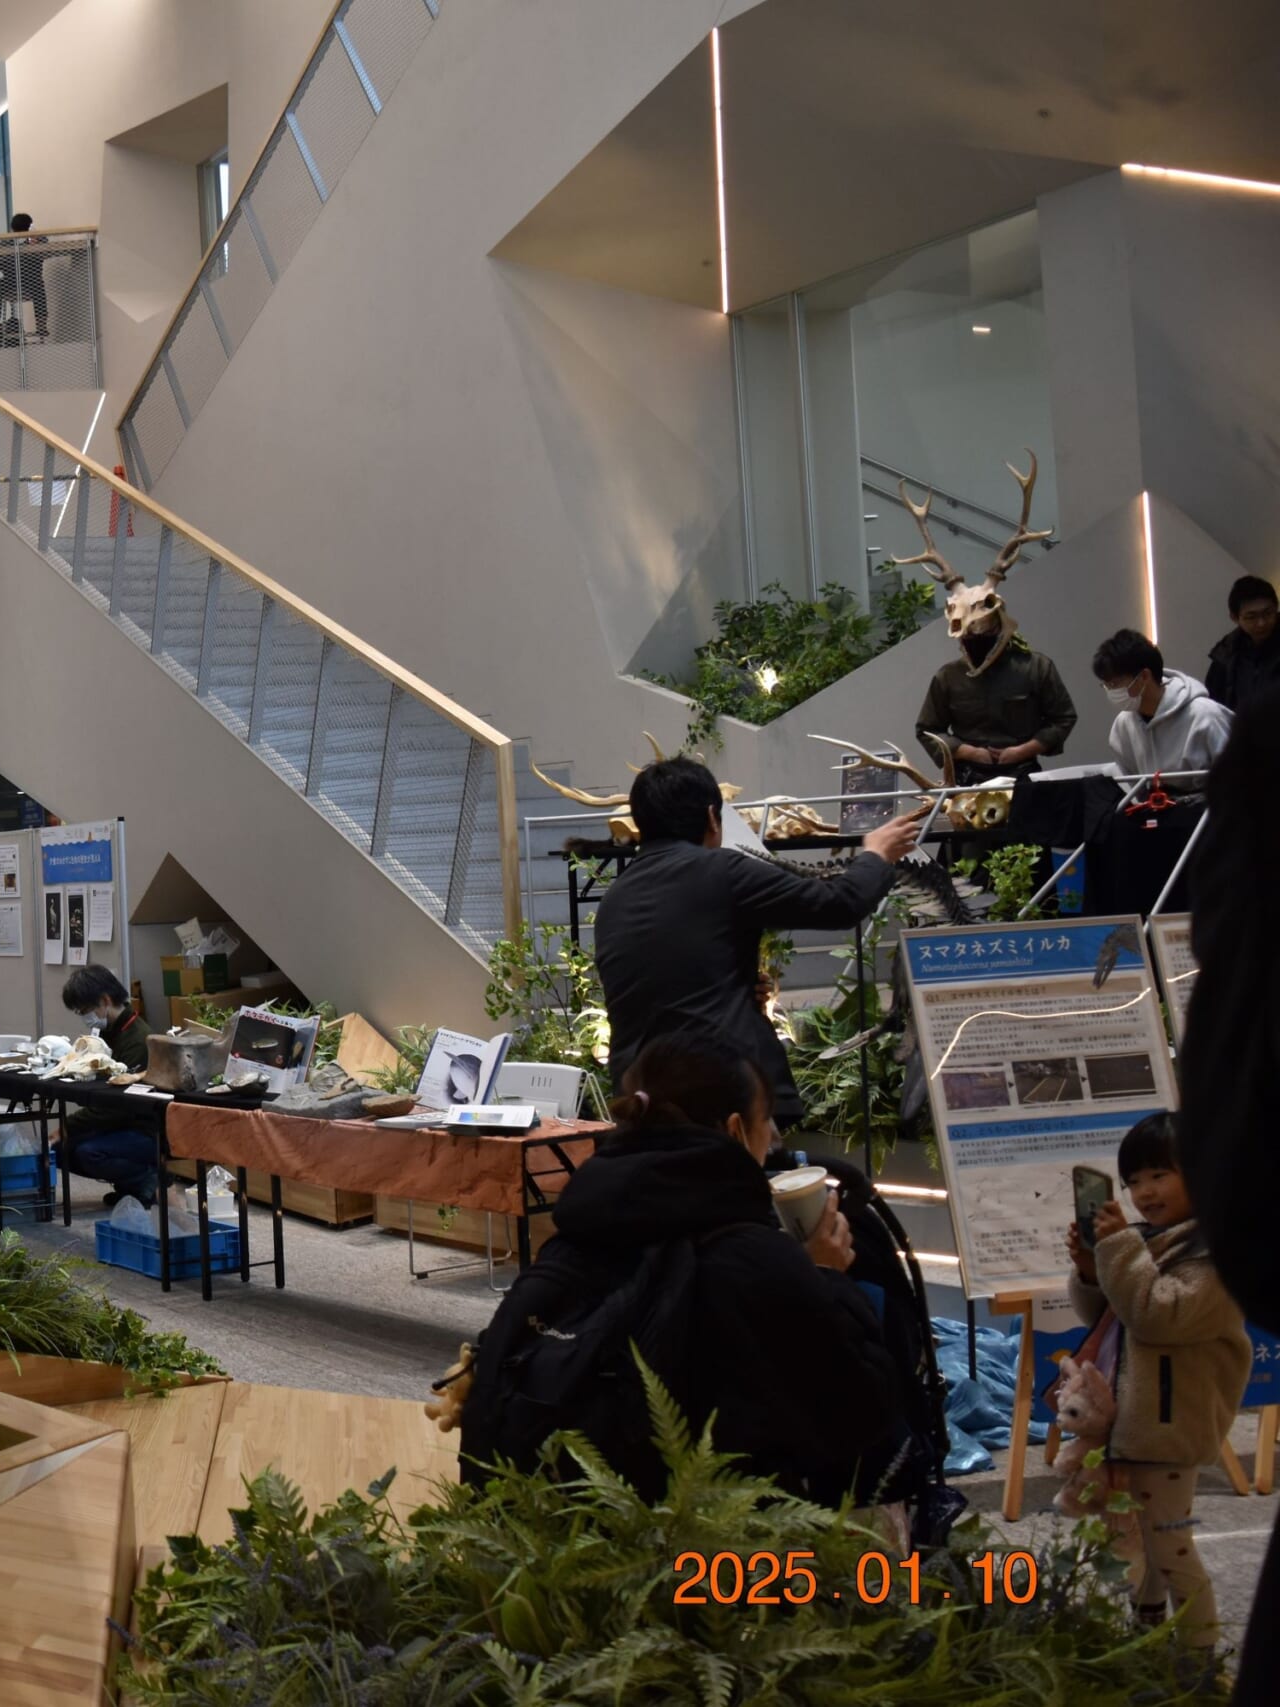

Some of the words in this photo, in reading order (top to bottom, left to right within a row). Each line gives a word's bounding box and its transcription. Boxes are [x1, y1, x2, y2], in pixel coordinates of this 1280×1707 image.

[919, 935, 1071, 960] ヌマタネズミイルカ
